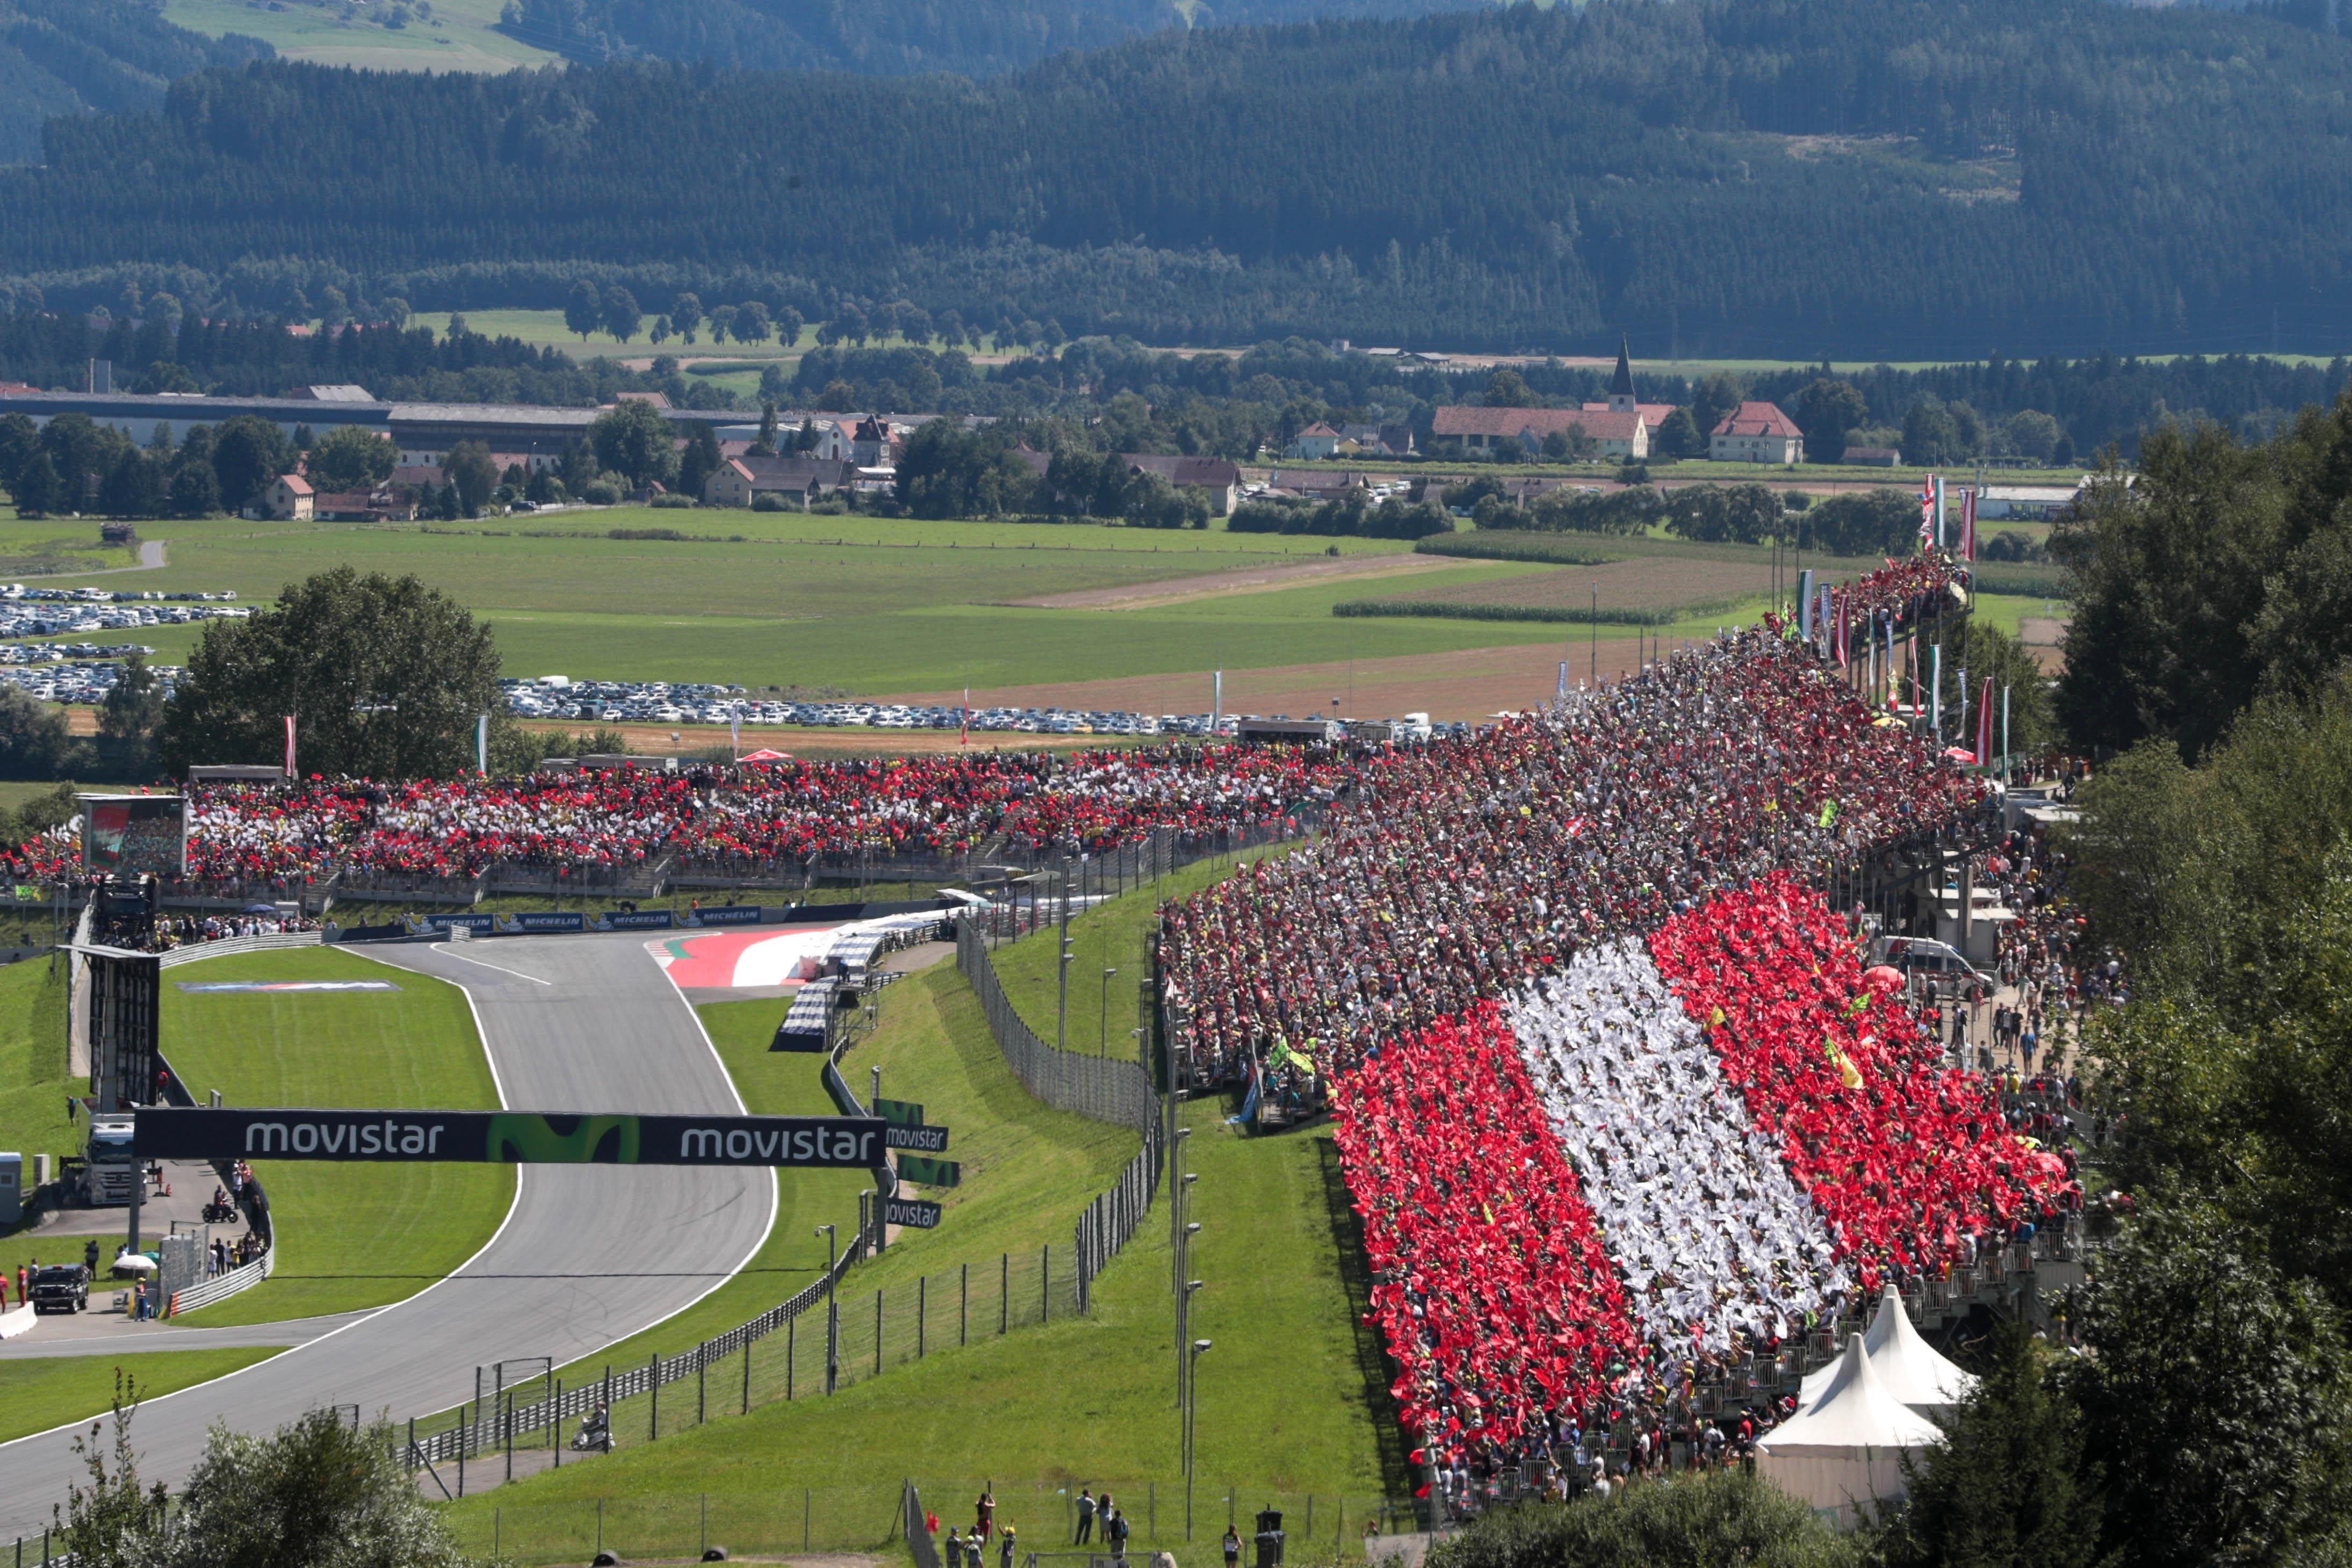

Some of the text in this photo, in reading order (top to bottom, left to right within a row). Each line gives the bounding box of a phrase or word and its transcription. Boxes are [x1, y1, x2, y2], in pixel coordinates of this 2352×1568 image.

[615, 915, 669, 924] MICHELIN
[703, 911, 758, 920] MICHELIN
[246, 1120, 444, 1154] movistar
[681, 1126, 876, 1161] movistar
[886, 1128, 944, 1150] movistar
[885, 1204, 937, 1226] ovistar
